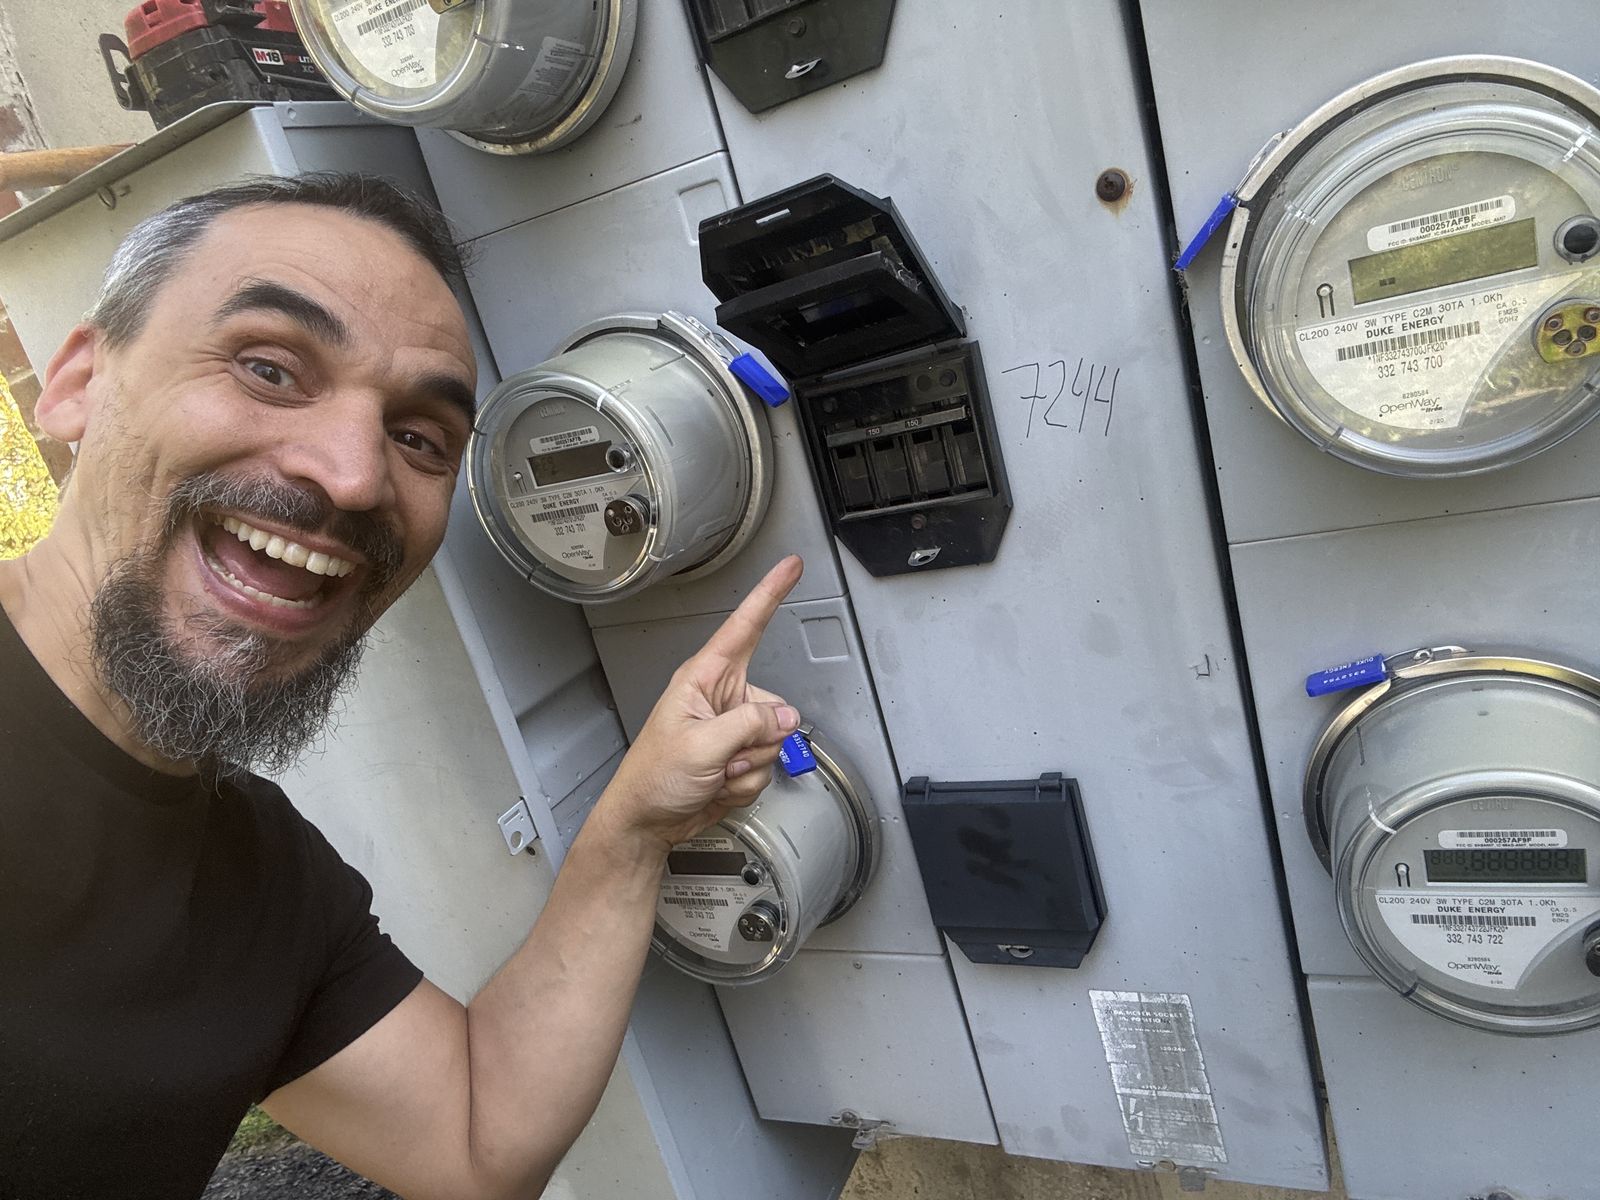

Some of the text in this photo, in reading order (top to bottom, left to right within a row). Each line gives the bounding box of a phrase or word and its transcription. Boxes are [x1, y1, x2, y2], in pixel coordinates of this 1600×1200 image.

[368, 2, 382, 15] DUKE
[254, 49, 281, 63] M18
[302, 65, 315, 73] XC
[1299, 292, 1503, 342] CL200 240V 3W TYPE C2M 30TA 1.0Kh
[1366, 315, 1444, 338] DUKE ENERGY
[1378, 354, 1443, 379] 332 743 700
[1001, 357, 1120, 439] 7244
[1380, 397, 1438, 414] OpenWay
[907, 419, 919, 427] 150
[868, 428, 880, 436] 150
[548, 493, 560, 501] TYPE
[542, 498, 580, 510] DUKE ENERGY
[565, 525, 576, 534] 743
[561, 549, 590, 559] OpenWay
[1468, 906, 1505, 914] ENERGY
[1446, 933, 1503, 944] 332 743 722
[1447, 961, 1498, 971] OpenWay
